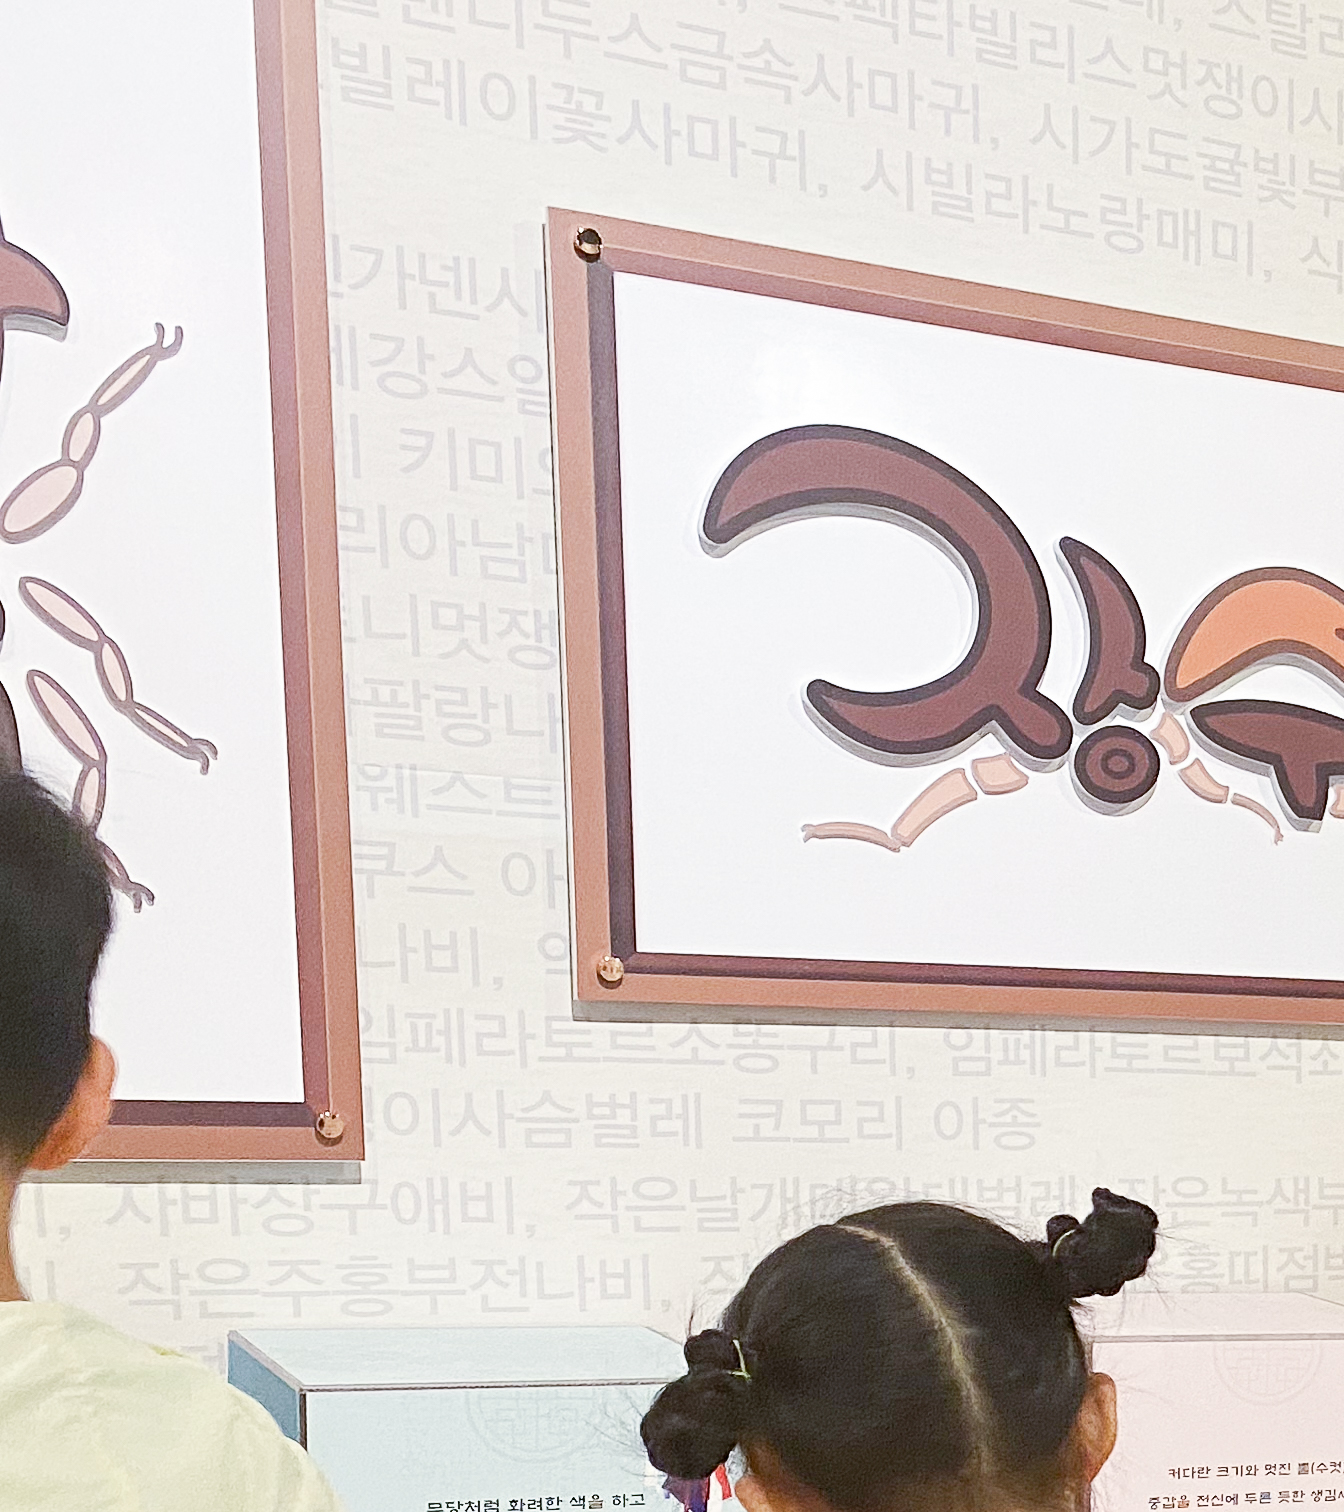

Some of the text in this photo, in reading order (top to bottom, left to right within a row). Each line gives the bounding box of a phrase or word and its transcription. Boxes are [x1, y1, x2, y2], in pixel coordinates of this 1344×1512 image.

[860, 146, 1275, 284] 시빌라노랑매미,
[732, 1096, 903, 1151] 코모리
[933, 1097, 1043, 1151] 아종
[117, 1254, 673, 1321] 작은주홍부전나비,
[507, 1496, 563, 1512] 화려한
[569, 1494, 604, 1509] 색을
[612, 1492, 646, 1508] 하고
